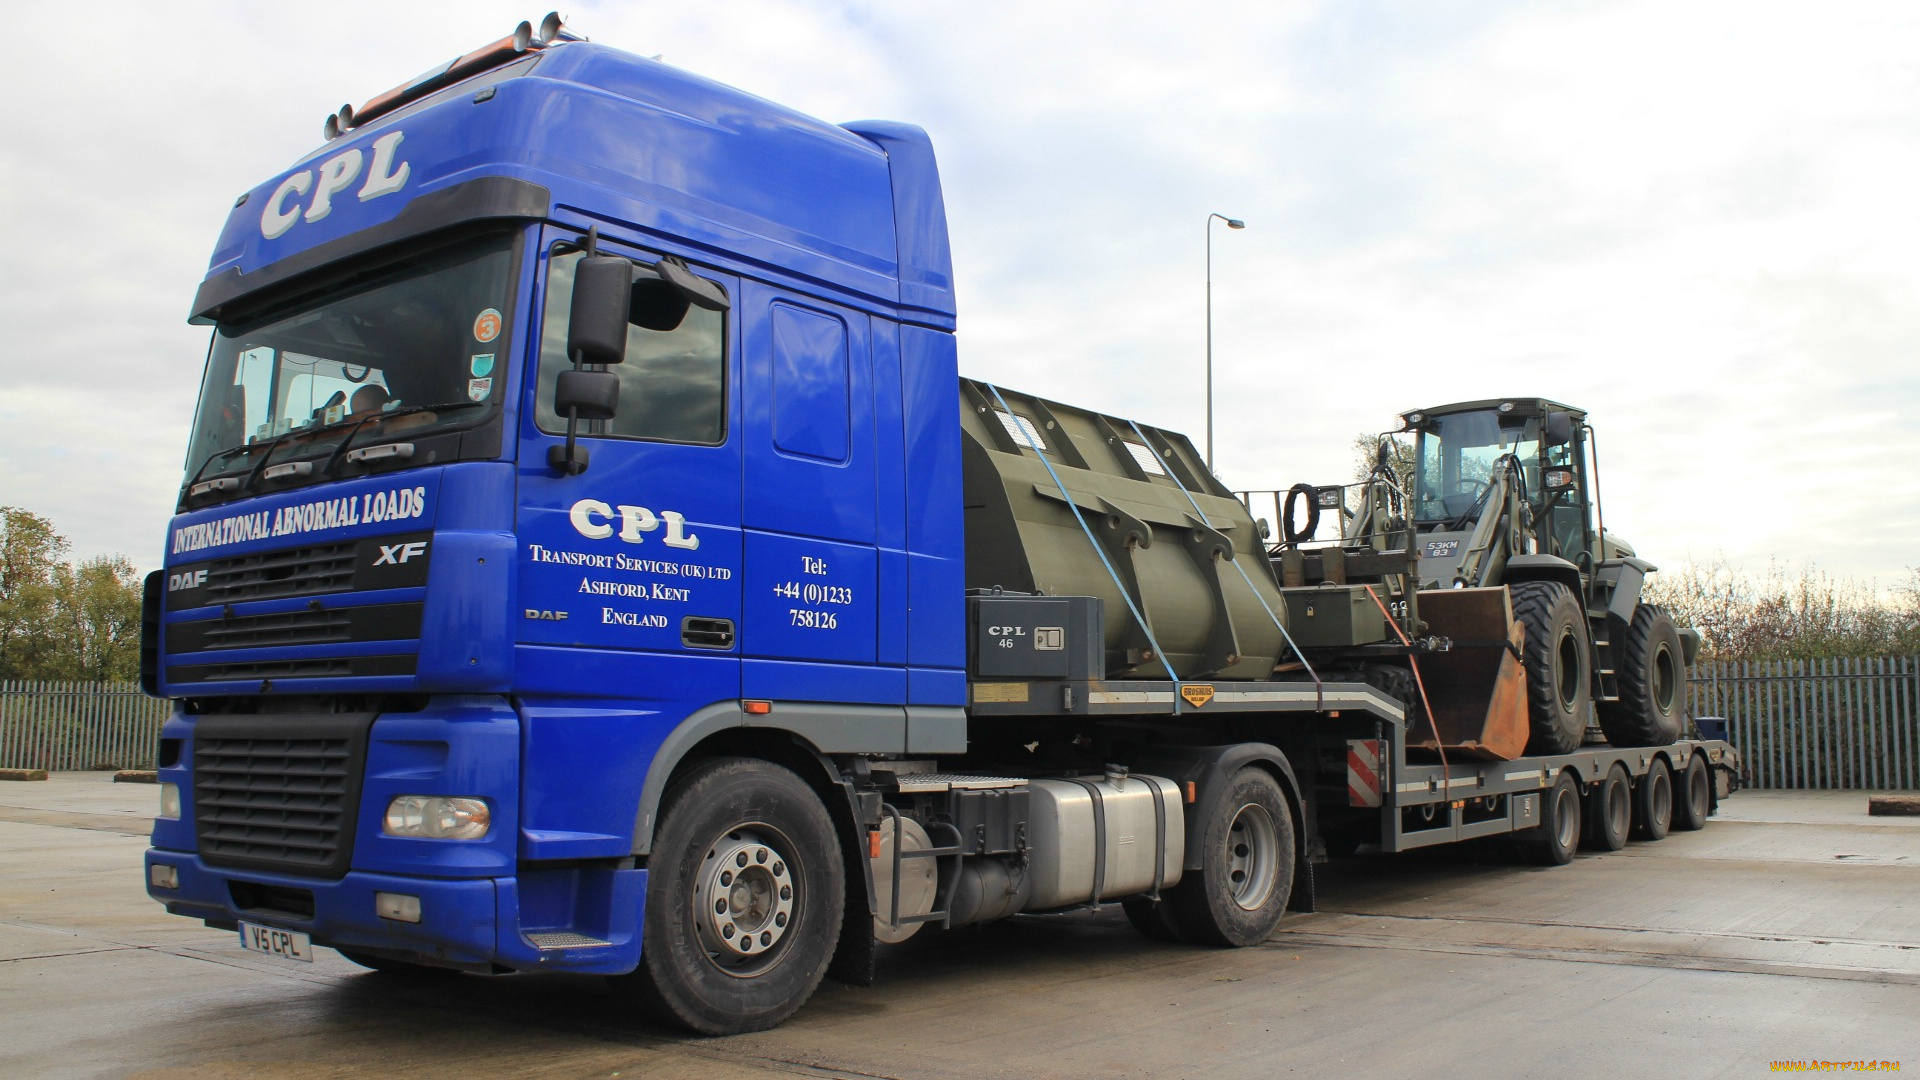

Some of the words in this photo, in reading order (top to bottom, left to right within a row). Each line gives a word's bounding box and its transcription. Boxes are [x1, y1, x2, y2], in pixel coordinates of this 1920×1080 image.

[260, 130, 411, 240] CPL
[481, 320, 495, 339] 3
[173, 511, 270, 554] INTERNATIONAL
[271, 496, 359, 536] ABNORMAL
[361, 486, 425, 524] LOADS
[570, 499, 699, 550] CPL
[372, 541, 428, 566] XF
[529, 544, 614, 568] TRANSPORT
[615, 553, 679, 575] SERVICES
[680, 564, 706, 580] (UK)
[707, 566, 731, 581] LTD
[1432, 549, 1448, 557] 83
[801, 556, 827, 576] Tel:
[168, 569, 208, 591] DAF
[578, 577, 650, 601] ASHFORD,
[651, 583, 691, 602] KENT
[773, 581, 800, 599] +44
[803, 583, 852, 606] (0)1233
[525, 608, 568, 621] DAF
[601, 607, 668, 629] ENGLAND
[789, 608, 837, 630] 758126
[988, 626, 1026, 636] CPL
[999, 639, 1014, 649] 46
[252, 926, 270, 950] V5
[272, 931, 300, 956] CPL
